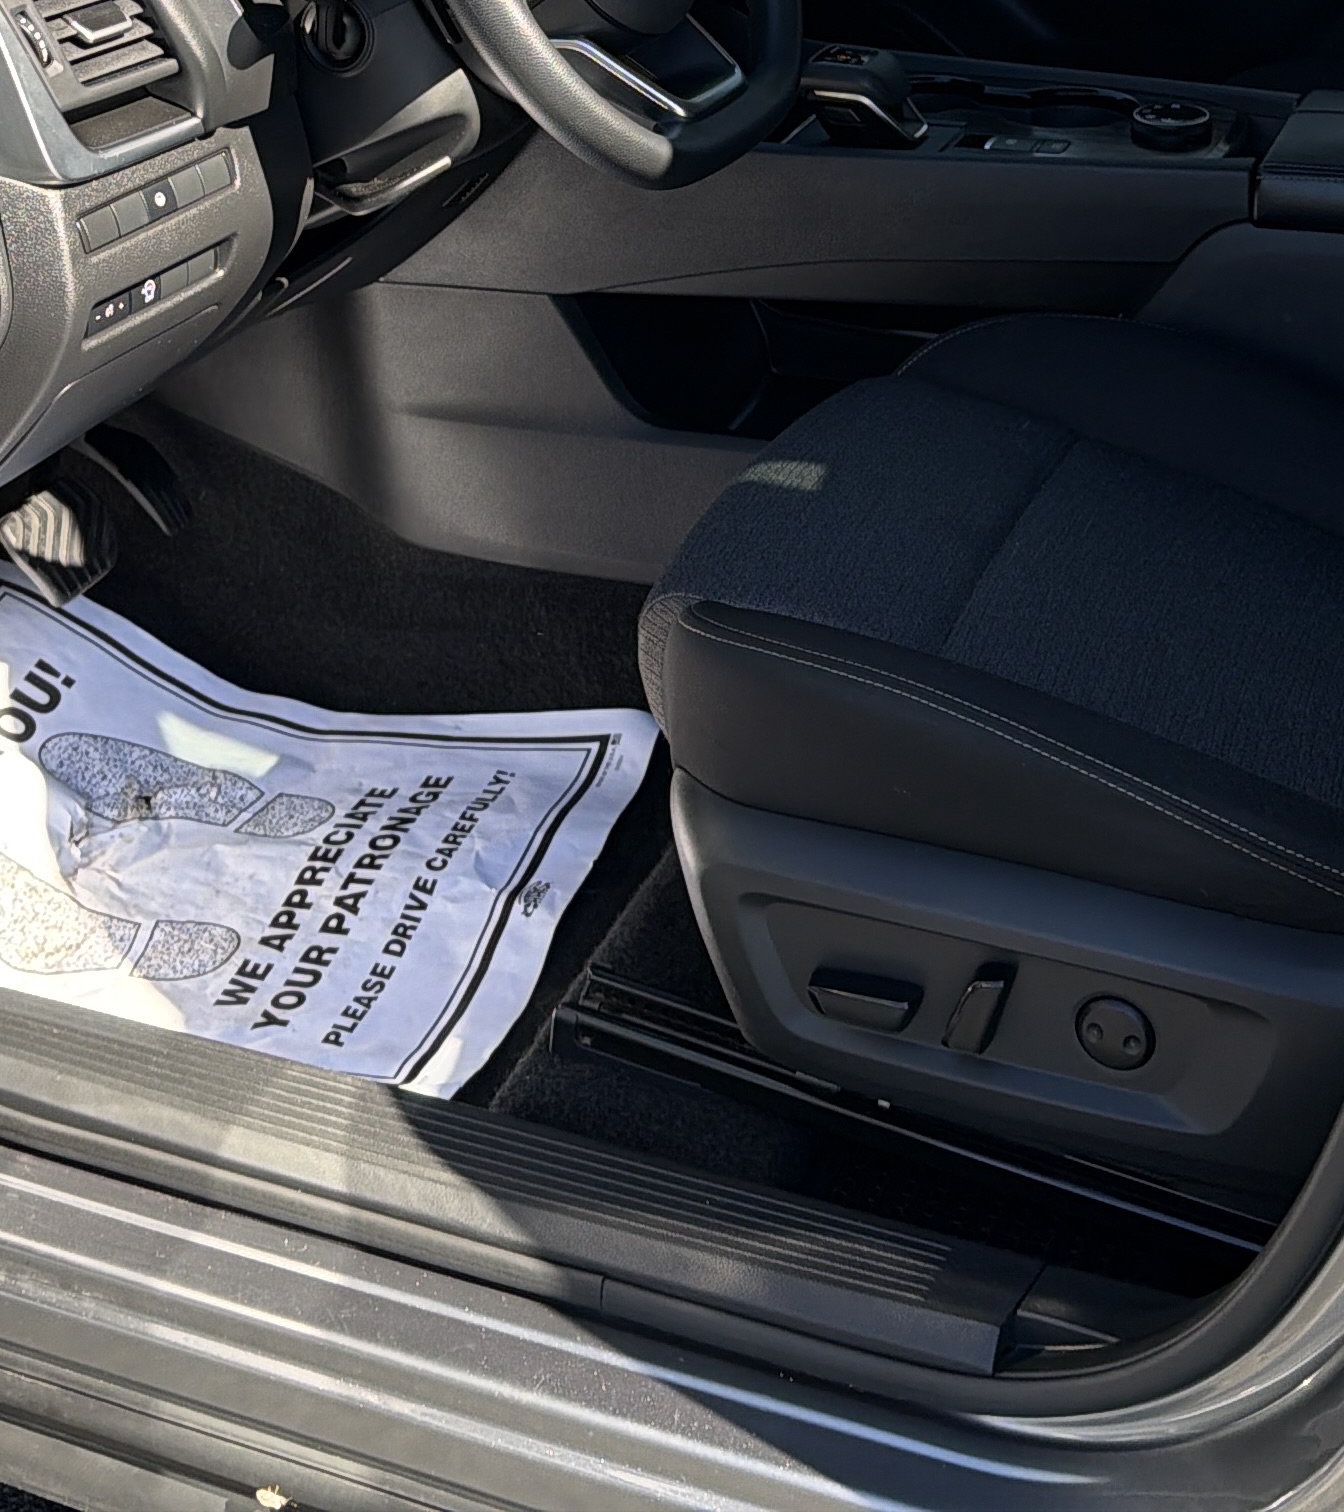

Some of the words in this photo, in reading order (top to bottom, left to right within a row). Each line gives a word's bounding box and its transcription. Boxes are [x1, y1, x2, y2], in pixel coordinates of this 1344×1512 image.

[213, 957, 275, 1007] WE
[257, 787, 400, 953] APPRECIATE
[250, 943, 340, 1031] YOUR
[318, 774, 455, 936] PATRONAGE
[320, 962, 397, 1048] PLEASE
[381, 875, 439, 958] DRIVE
[424, 769, 517, 872] CAREFULLY!
